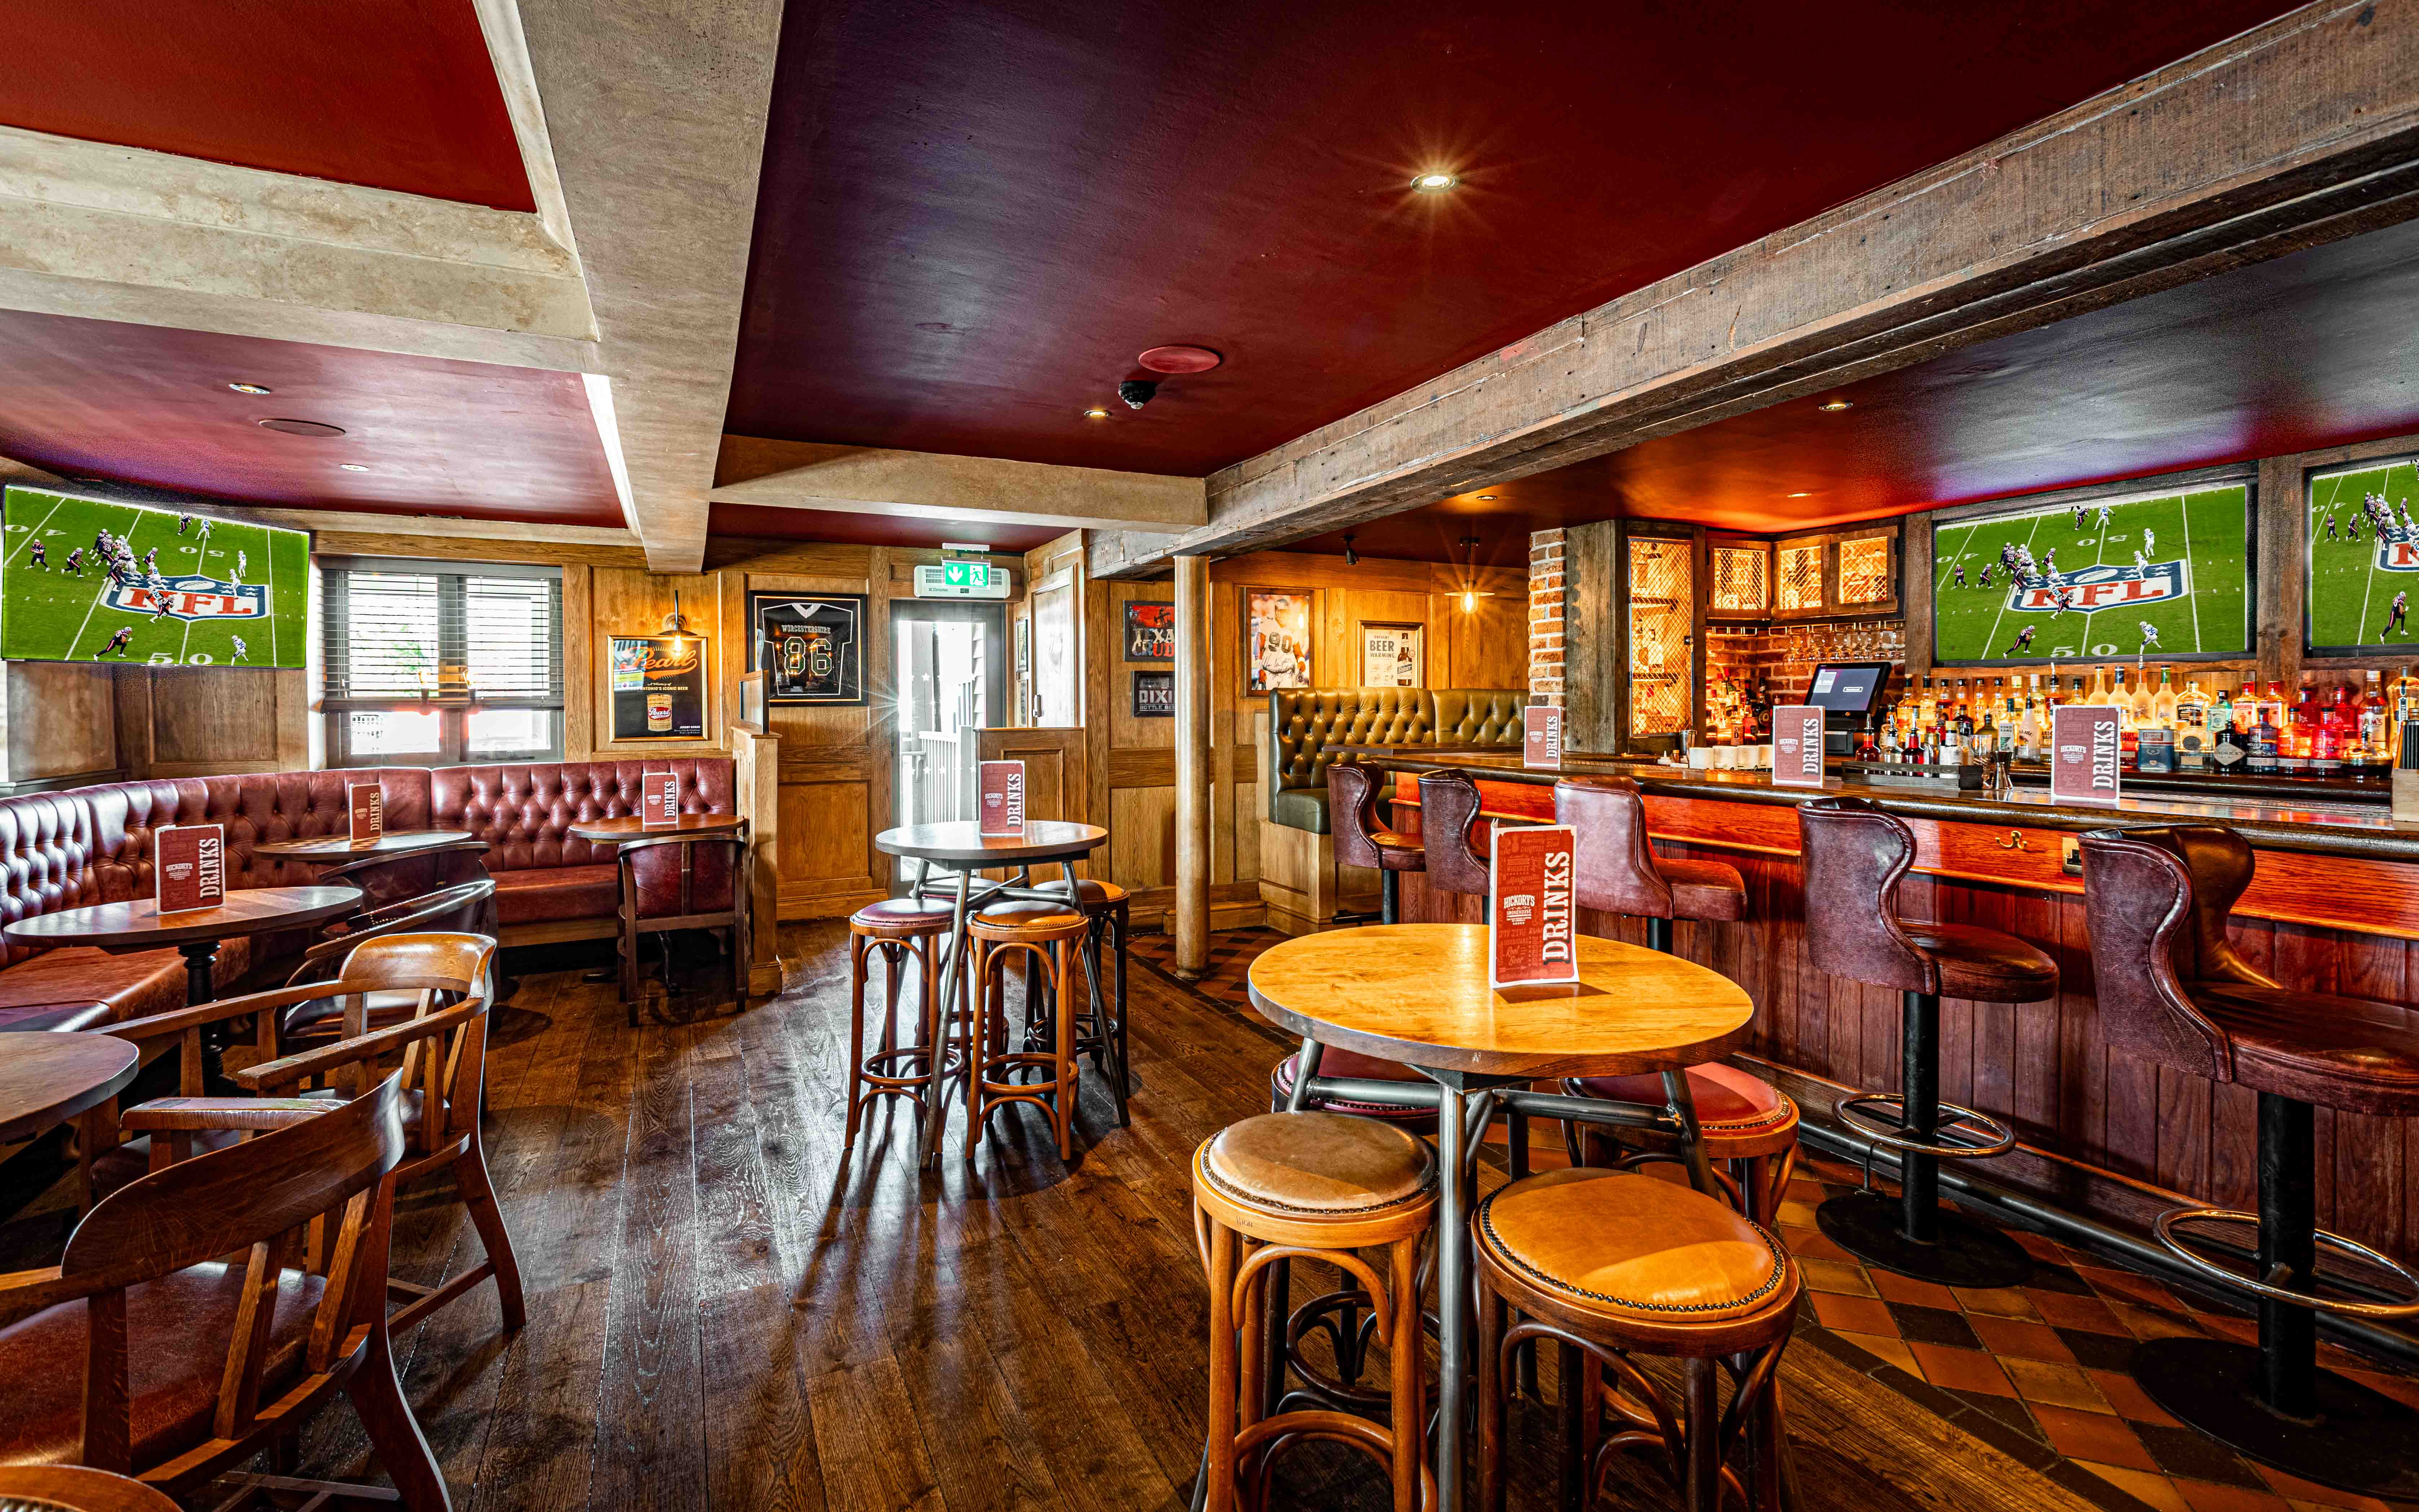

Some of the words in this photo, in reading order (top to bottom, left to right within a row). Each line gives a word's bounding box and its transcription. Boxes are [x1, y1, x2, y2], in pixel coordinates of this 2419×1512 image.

[124, 588, 252, 615] NFL
[2026, 580, 2163, 606] NFL
[782, 625, 831, 634] WORCESTERSHIRE
[1132, 628, 1175, 644] TEXA
[1268, 632, 1292, 653] 90
[784, 637, 832, 676] 86
[1132, 640, 1175, 657] CRUD
[1370, 640, 1394, 652] BEER
[619, 646, 697, 675] Pearl
[1139, 690, 1172, 703] DIXI
[649, 708, 671, 716] Pearl
[1546, 715, 1558, 758] DRINKS
[1803, 718, 1818, 773] DRINKS
[2092, 721, 2115, 788] DRINKS
[370, 792, 380, 831] DRINKS
[664, 781, 675, 817] DRINKS
[1007, 773, 1021, 826] DRINKS
[199, 838, 220, 898] DRINKS
[1503, 894, 1535, 909] HICKORY'S
[1542, 852, 1570, 962] DRINKS
